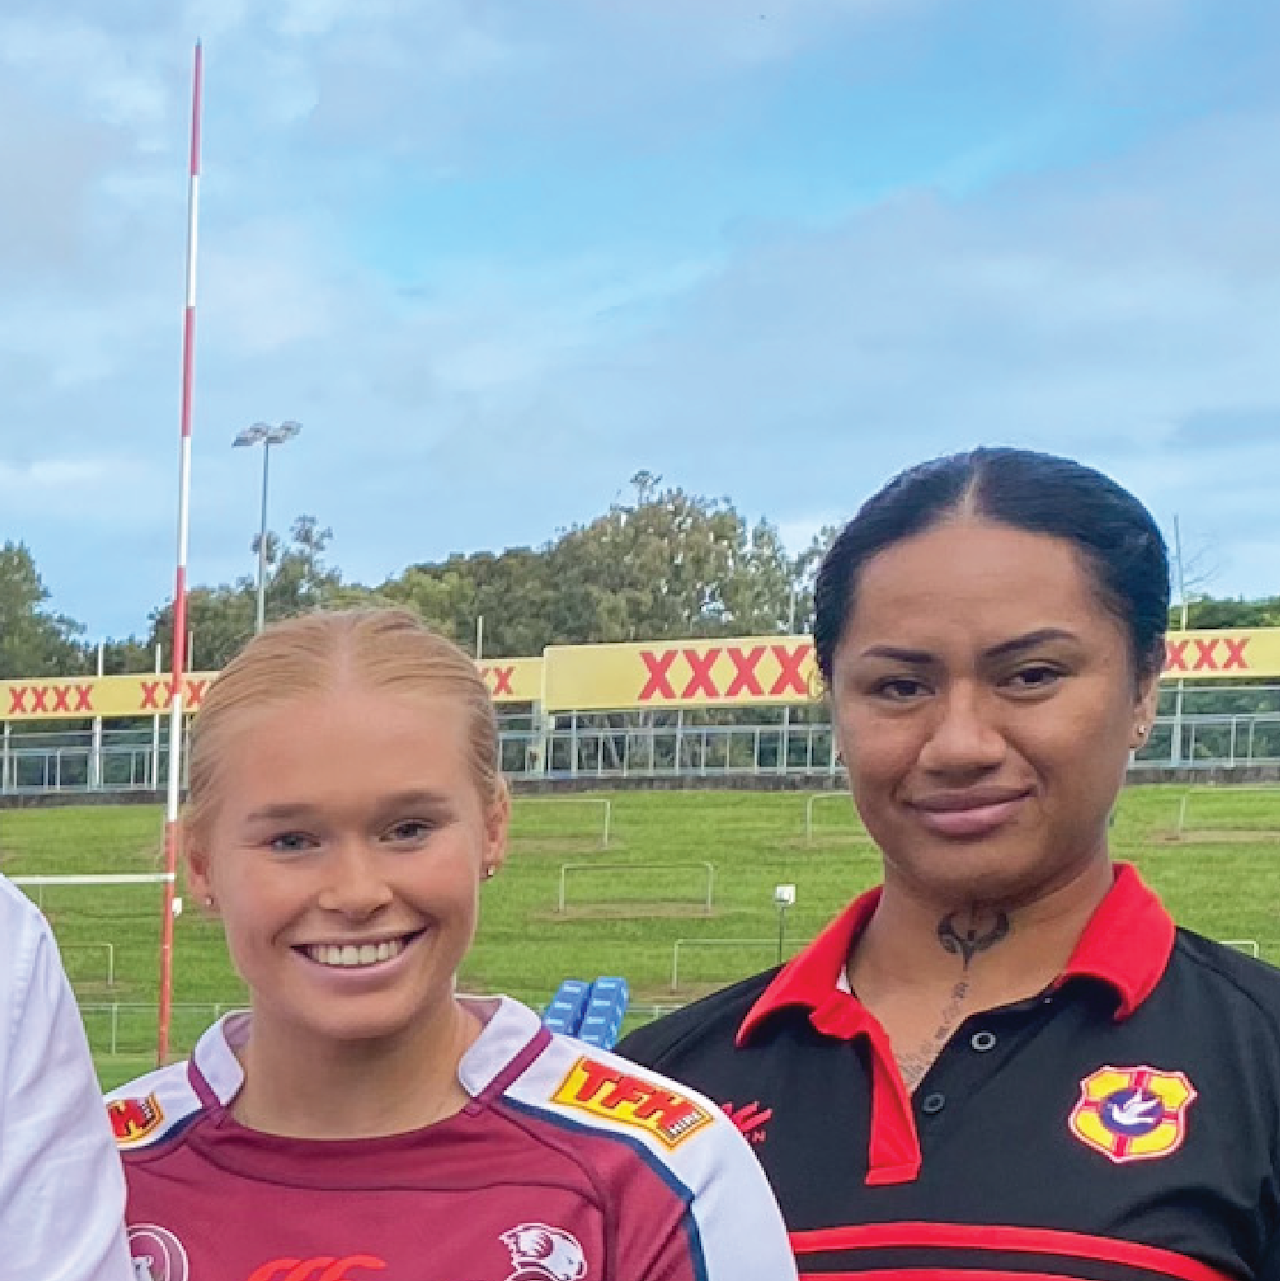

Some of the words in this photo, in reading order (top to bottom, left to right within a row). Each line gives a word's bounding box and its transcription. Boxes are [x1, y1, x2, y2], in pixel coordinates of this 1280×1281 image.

[8, 684, 94, 714] XXXX
[638, 644, 813, 700] XXXX
[576, 1060, 700, 1133] TFH
